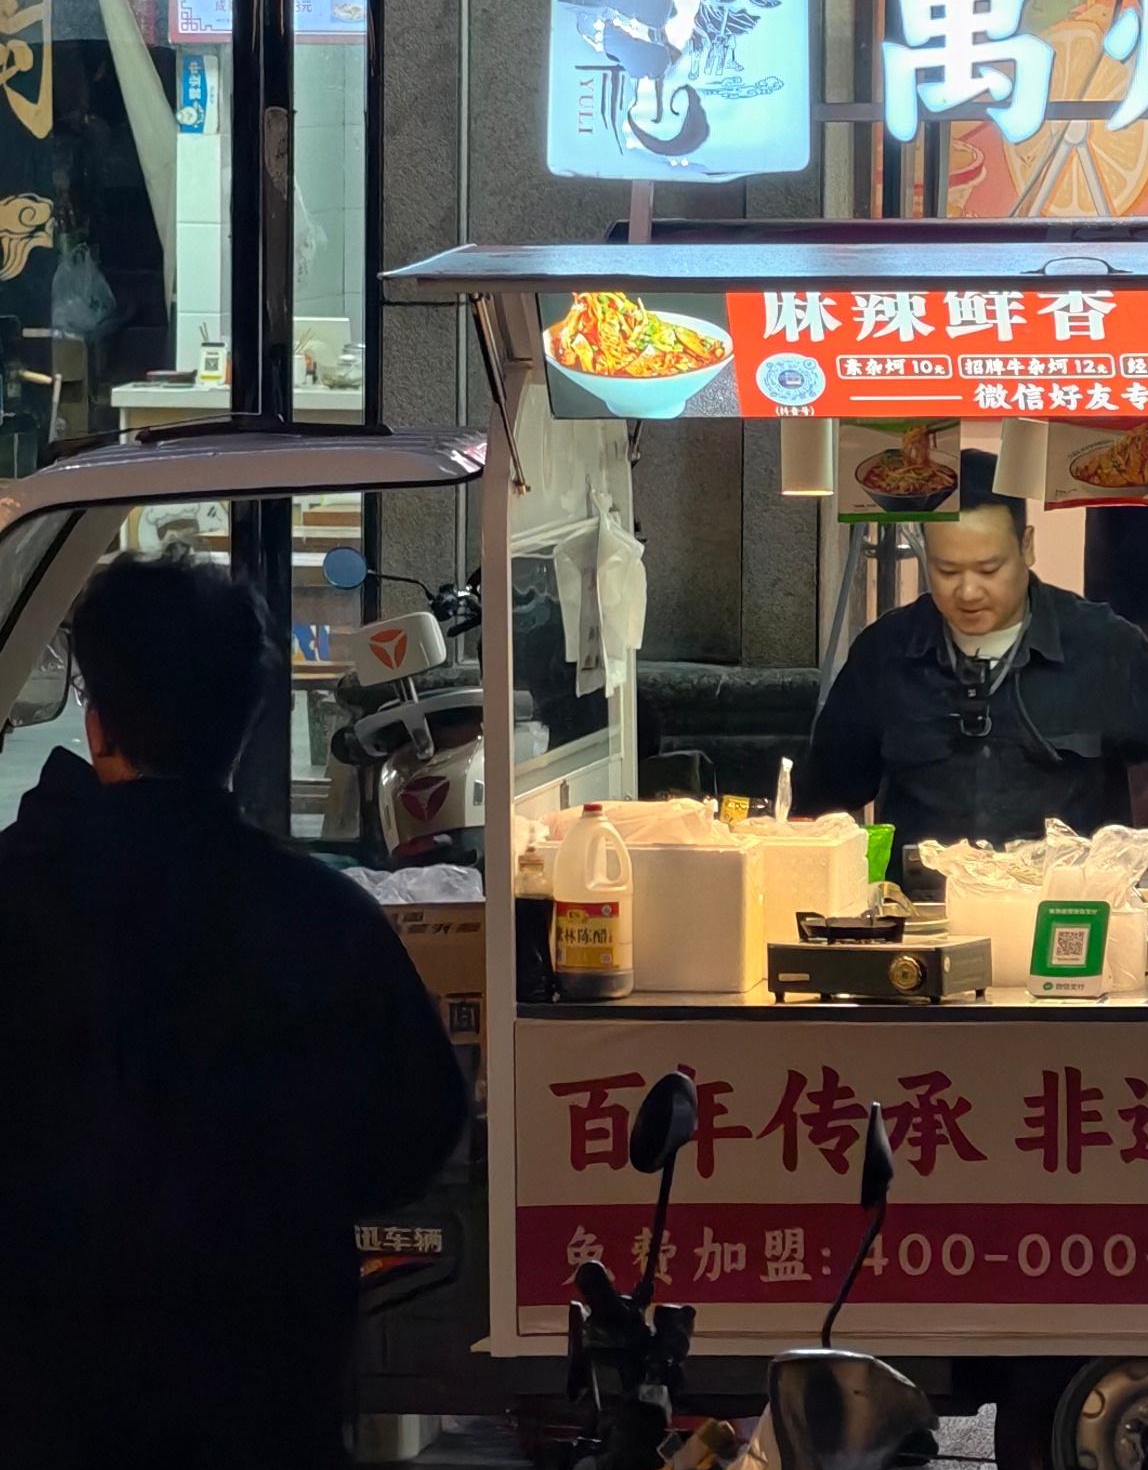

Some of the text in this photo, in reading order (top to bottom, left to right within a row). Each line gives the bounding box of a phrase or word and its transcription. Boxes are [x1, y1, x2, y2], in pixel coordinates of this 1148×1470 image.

[763, 291, 1118, 343] 麻辣鲜香
[549, 1064, 987, 1179] 百年传承
